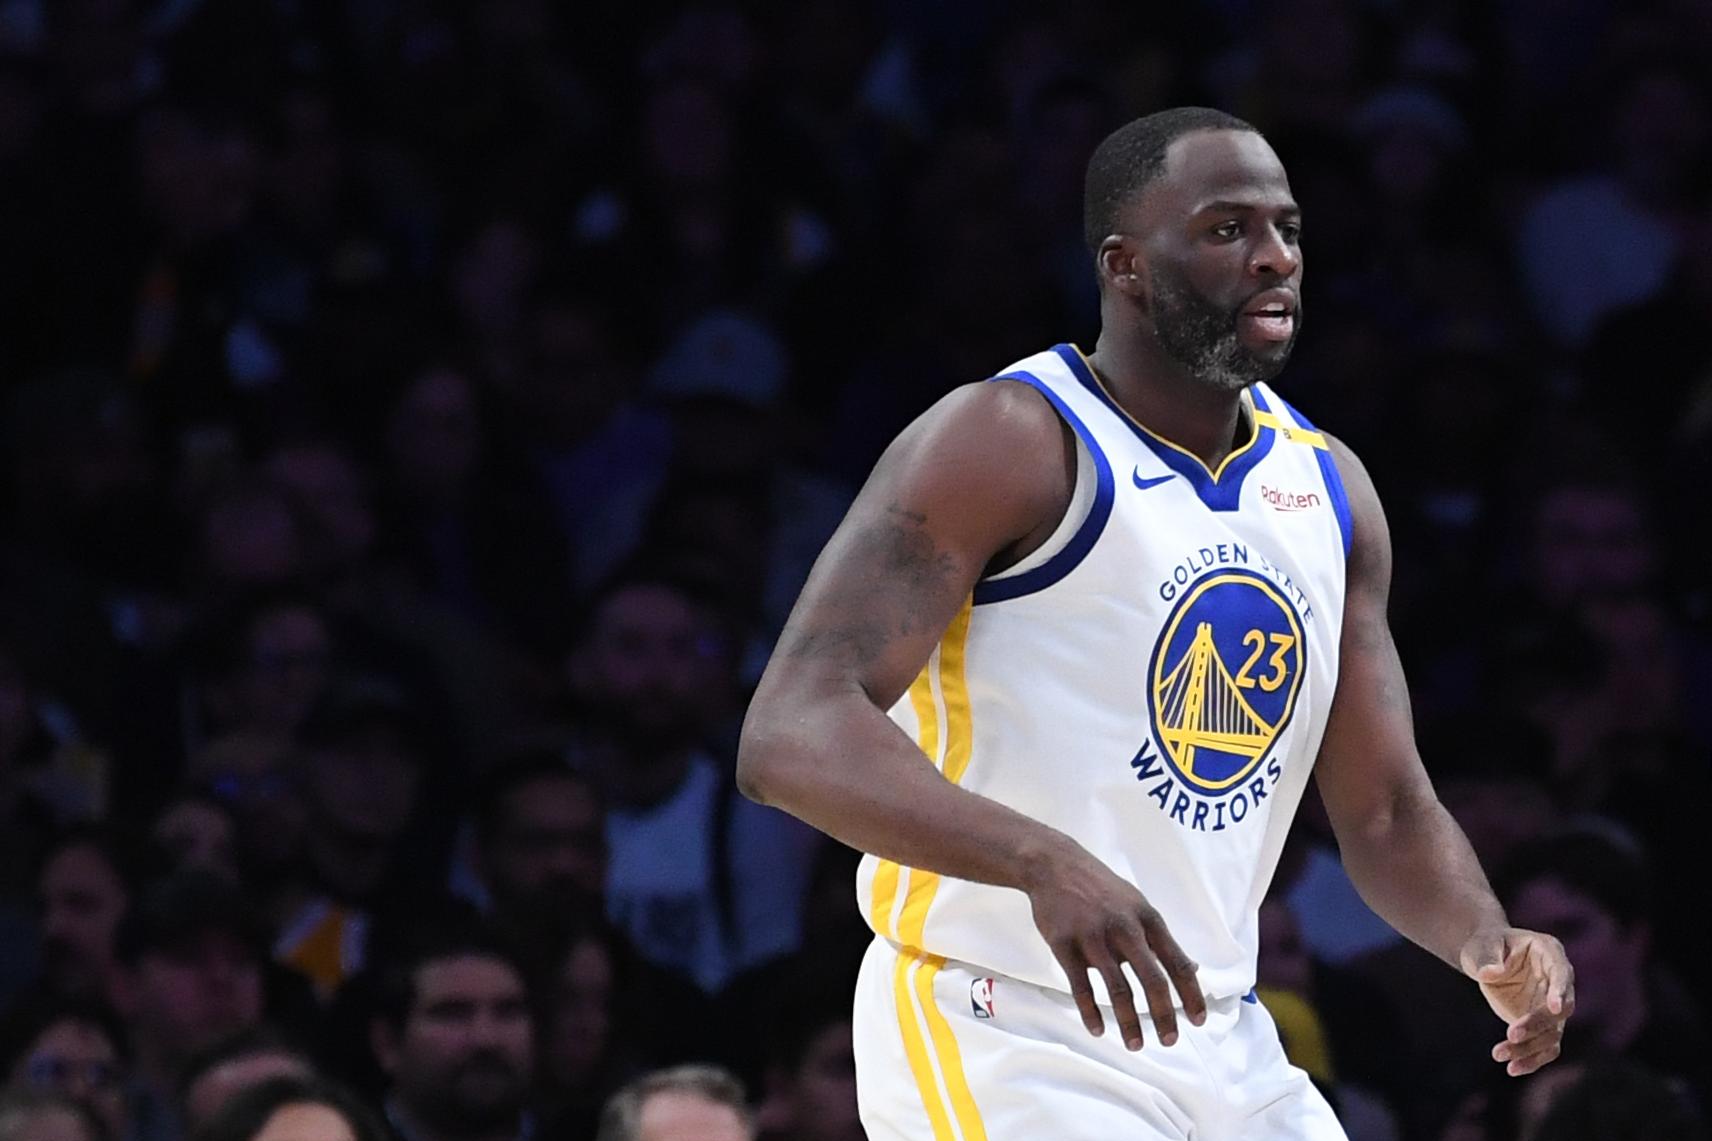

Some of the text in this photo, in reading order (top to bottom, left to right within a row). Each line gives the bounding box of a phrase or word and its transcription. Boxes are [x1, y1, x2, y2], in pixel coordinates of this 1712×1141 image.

[1158, 542, 1249, 603] GOLDEN
[1235, 628, 1295, 693] 23
[1129, 737, 1282, 833] WARRIORS
